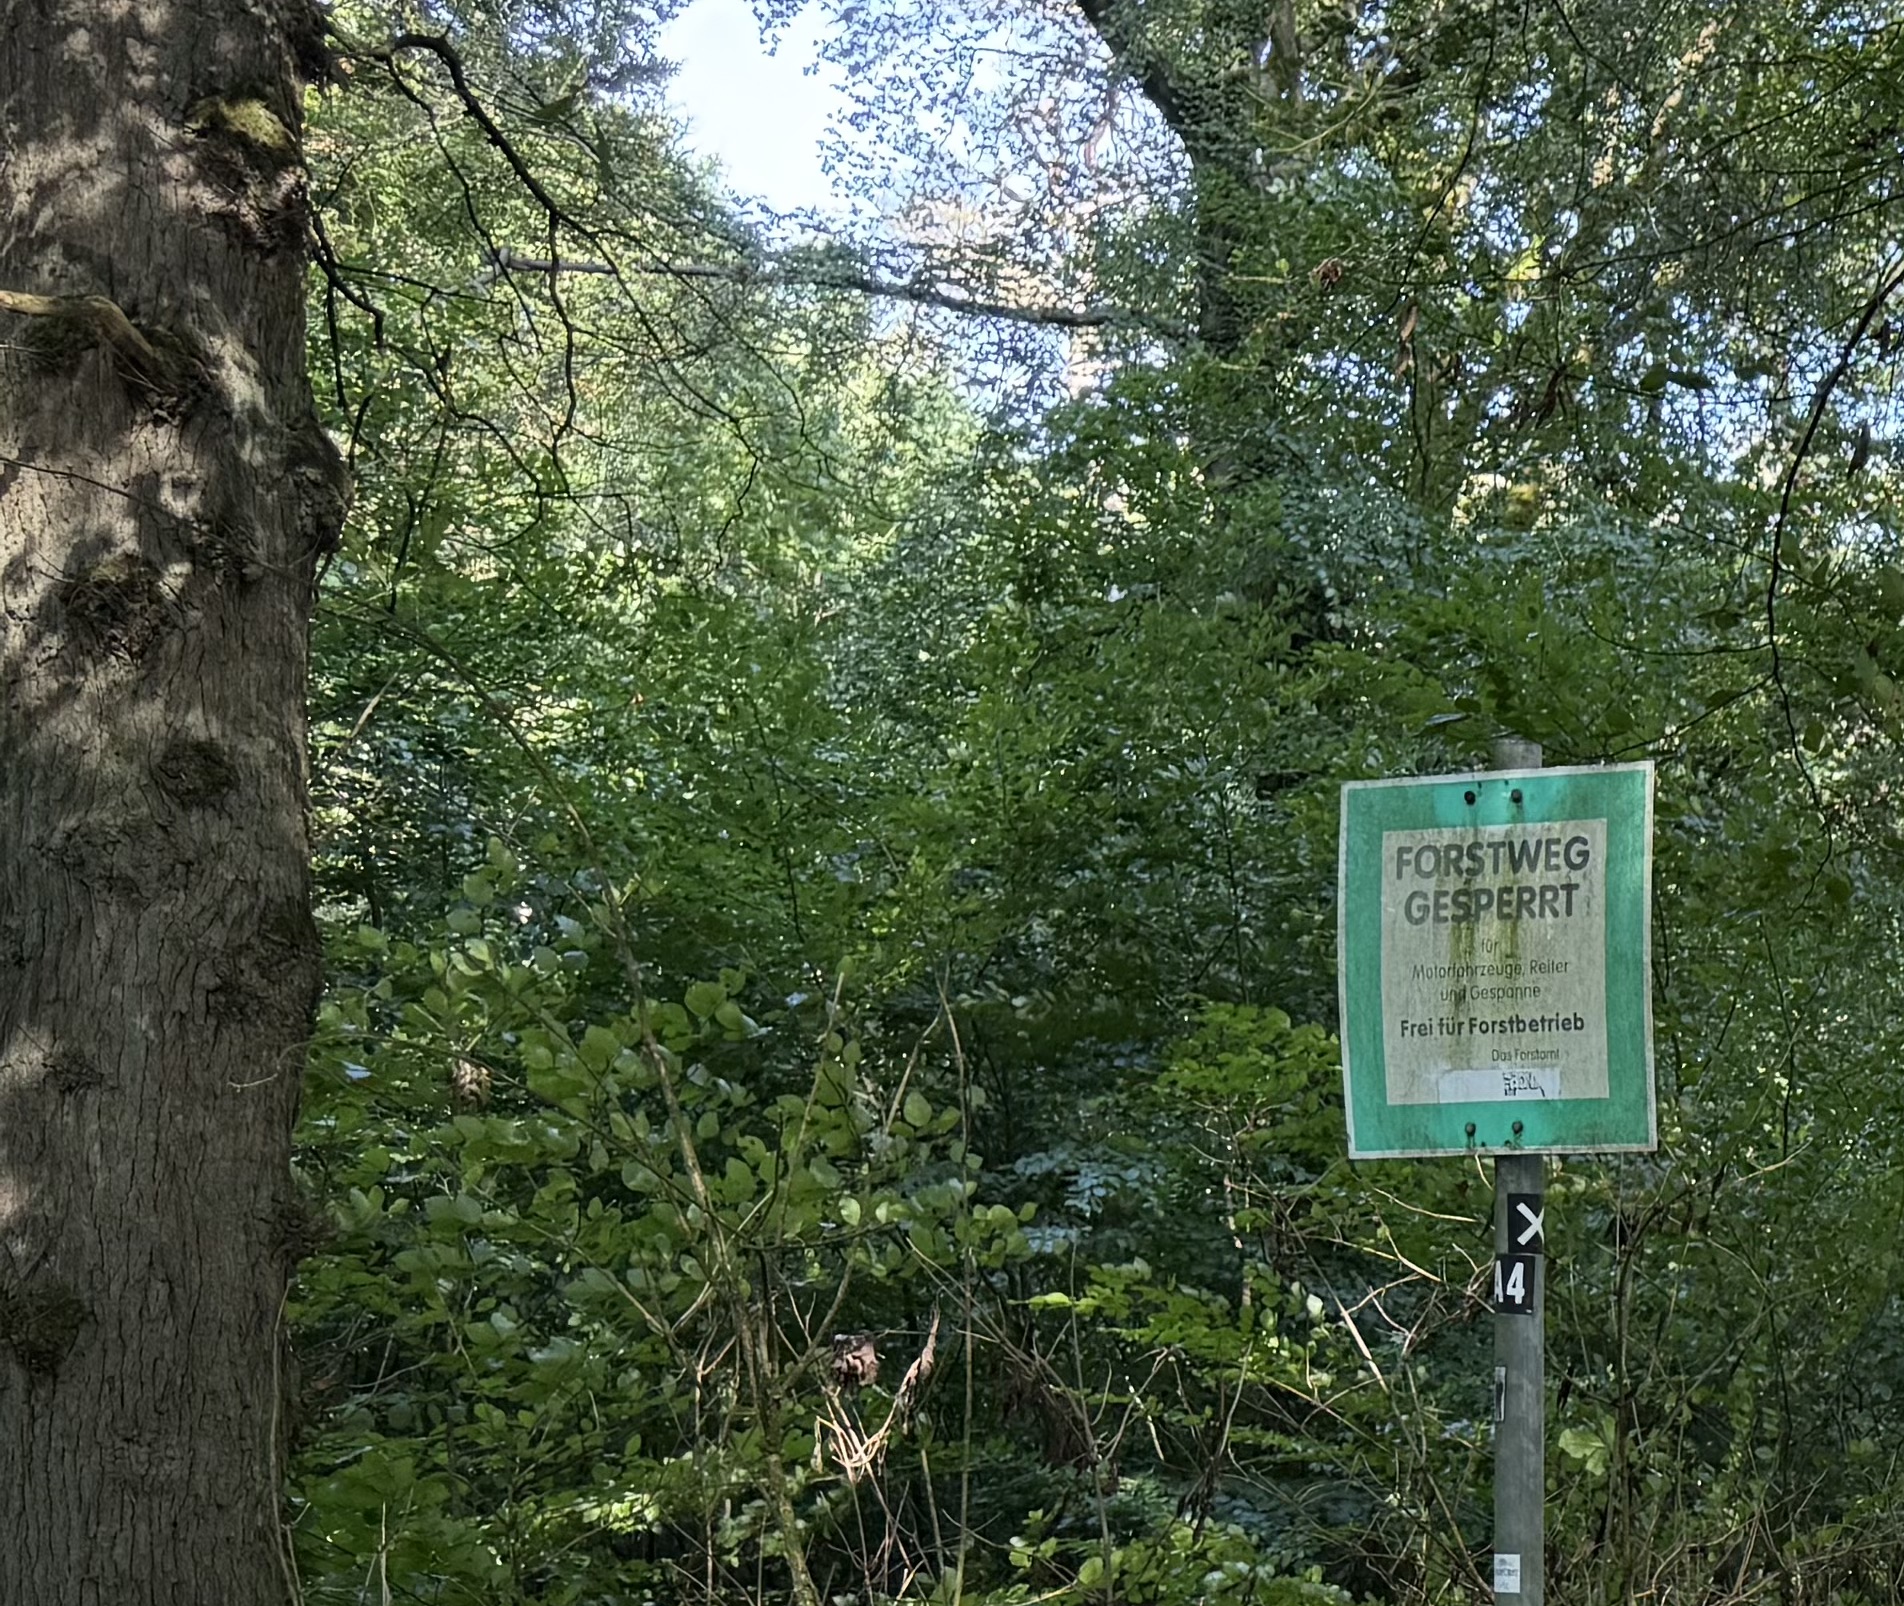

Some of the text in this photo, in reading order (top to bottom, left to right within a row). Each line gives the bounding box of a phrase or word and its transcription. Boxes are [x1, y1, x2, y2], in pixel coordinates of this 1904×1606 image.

[1396, 835, 1590, 880] FORSTWEG
[1404, 883, 1580, 926] GESPERRT
[1481, 938, 1500, 954] für
[1412, 959, 1569, 981] Motorfahrzeuge, Reiter
[1440, 984, 1541, 1003] und Gespanne
[1401, 1012, 1585, 1038] Frei für Forstbetrieb
[1491, 1048, 1560, 1062] Das Forstamt
